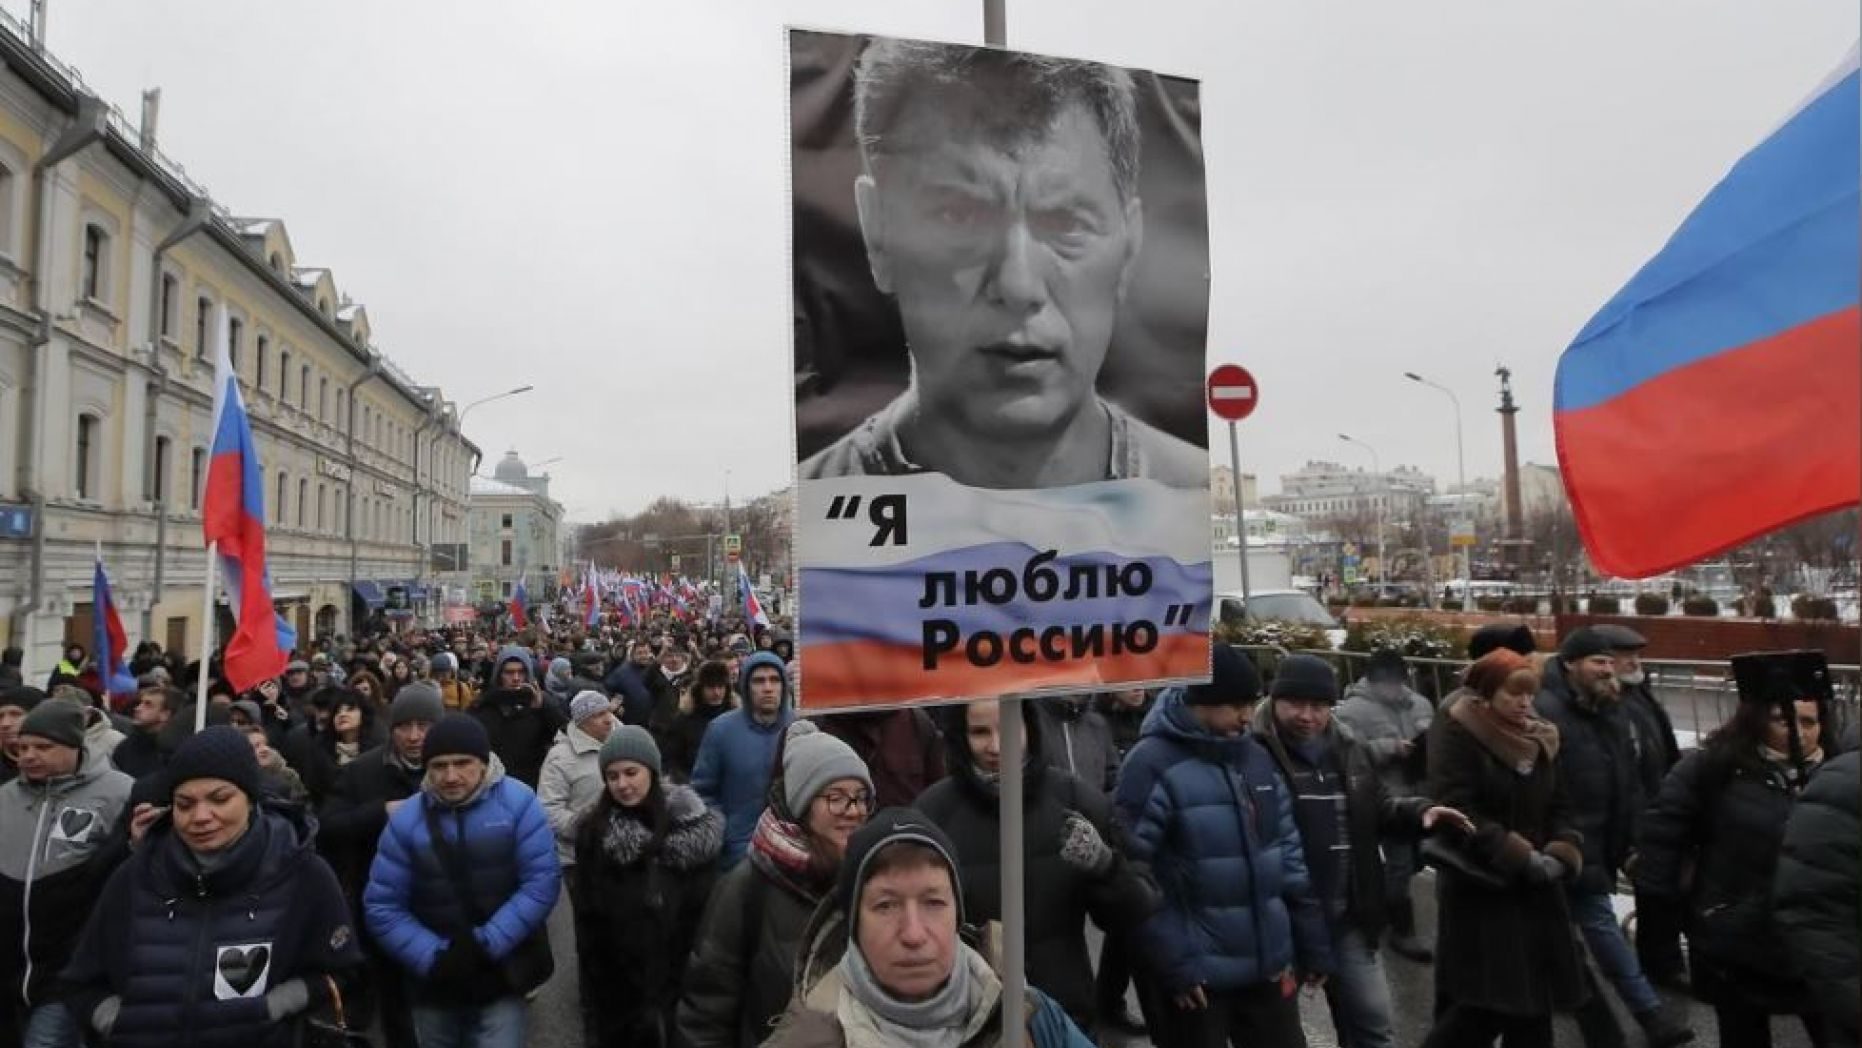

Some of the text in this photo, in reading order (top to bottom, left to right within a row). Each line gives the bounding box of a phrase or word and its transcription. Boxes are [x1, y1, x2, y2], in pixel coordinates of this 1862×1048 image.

[826, 494, 907, 547] "Я
[919, 549, 1153, 609] люблю
[921, 604, 1195, 671] Россию"
